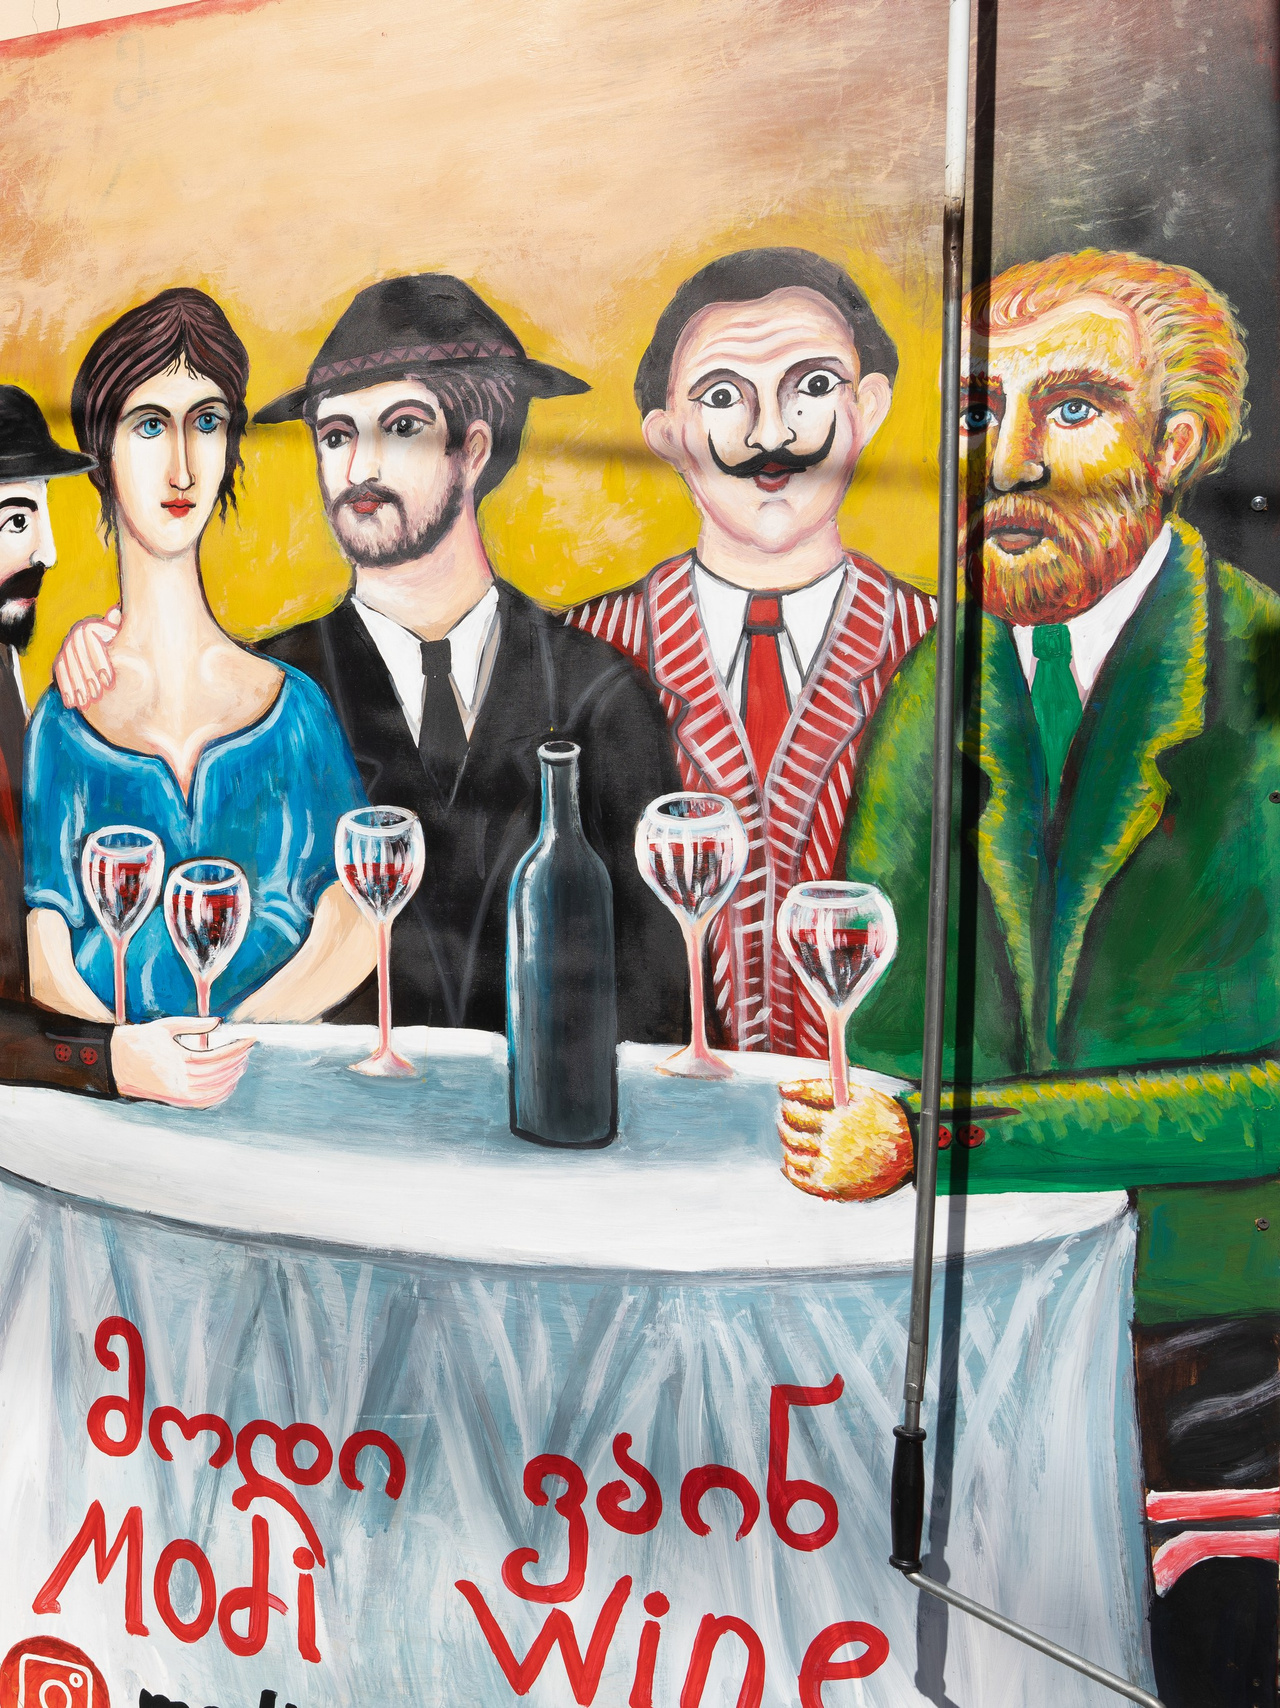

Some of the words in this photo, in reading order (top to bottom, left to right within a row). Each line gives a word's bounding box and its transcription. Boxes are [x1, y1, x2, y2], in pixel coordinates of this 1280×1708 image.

[86, 1315, 406, 1569] მოდი
[501, 1373, 844, 1604] ვაინ
[31, 1499, 322, 1664] Modi
[455, 1575, 890, 1708] Wine
